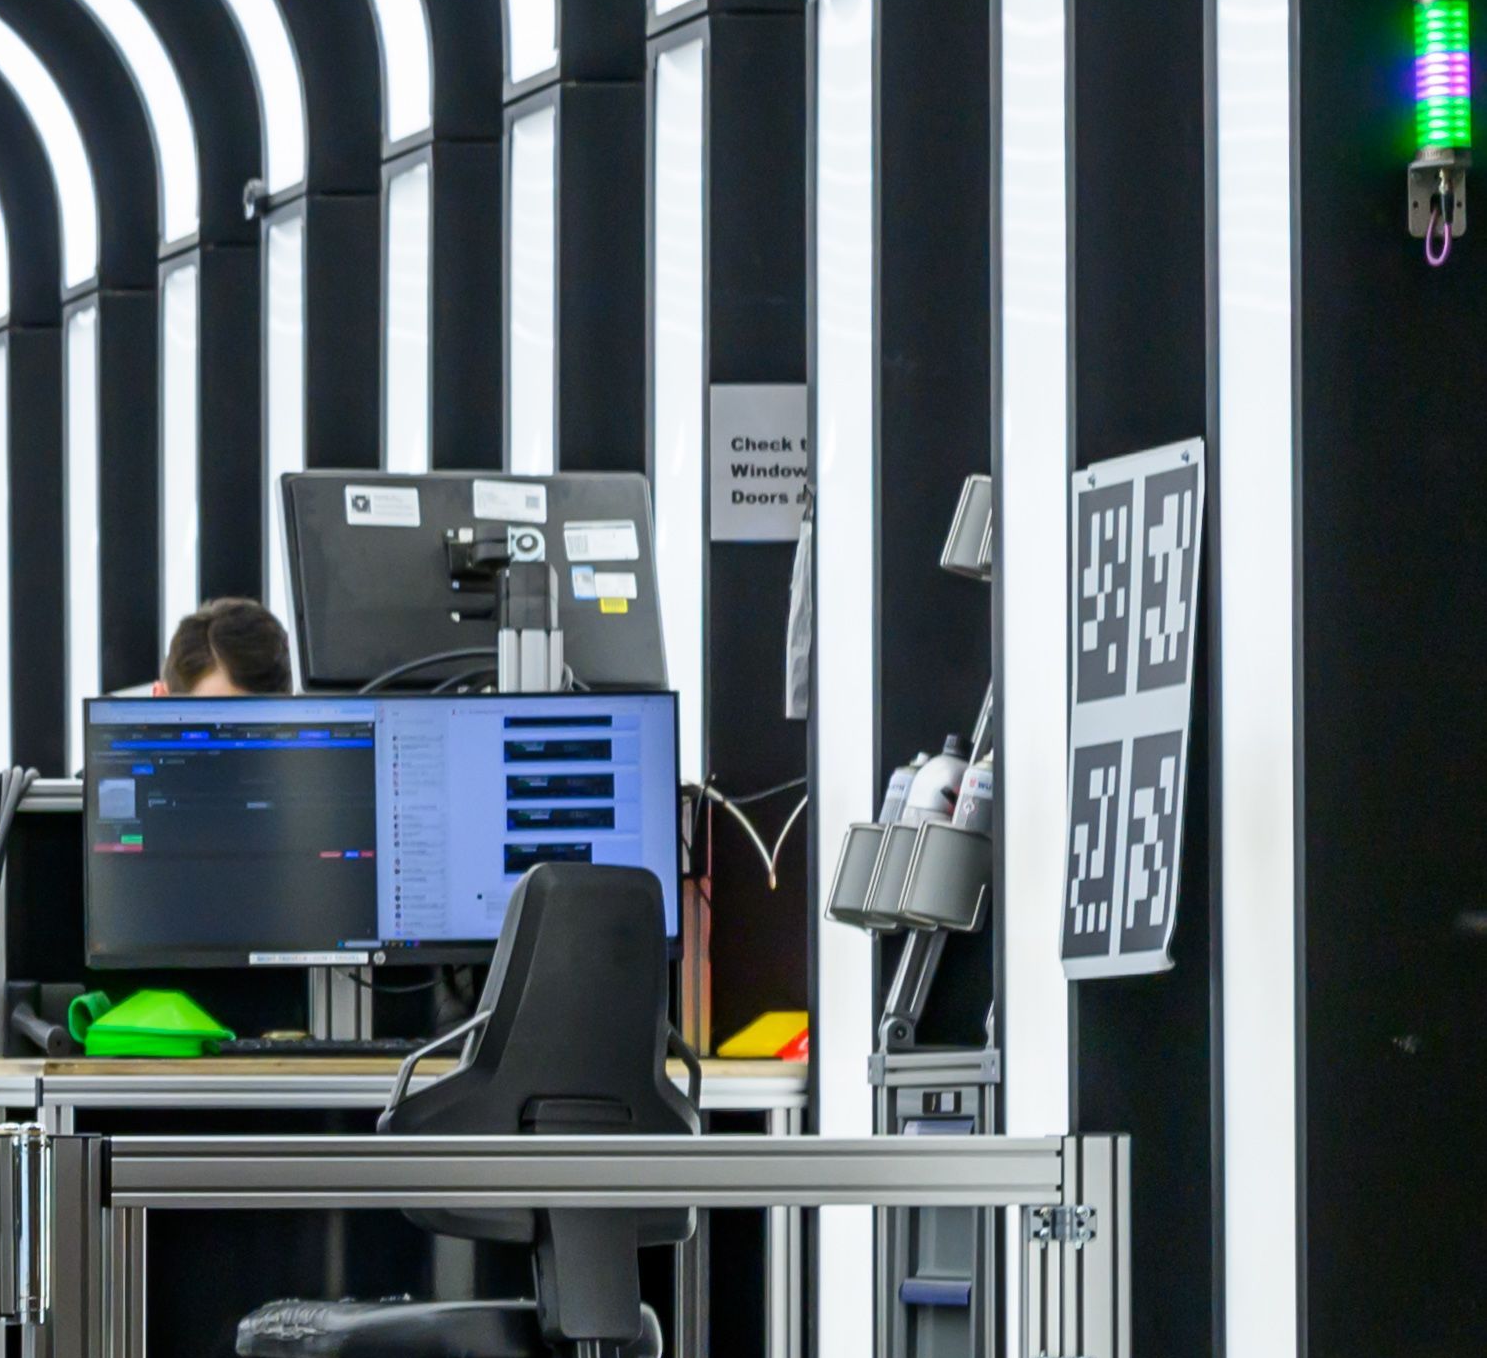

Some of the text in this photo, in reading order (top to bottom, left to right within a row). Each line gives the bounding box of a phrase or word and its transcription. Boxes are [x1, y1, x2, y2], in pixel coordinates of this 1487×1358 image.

[730, 437, 793, 452] Check
[730, 463, 808, 478] Window
[731, 490, 789, 504] Doors
